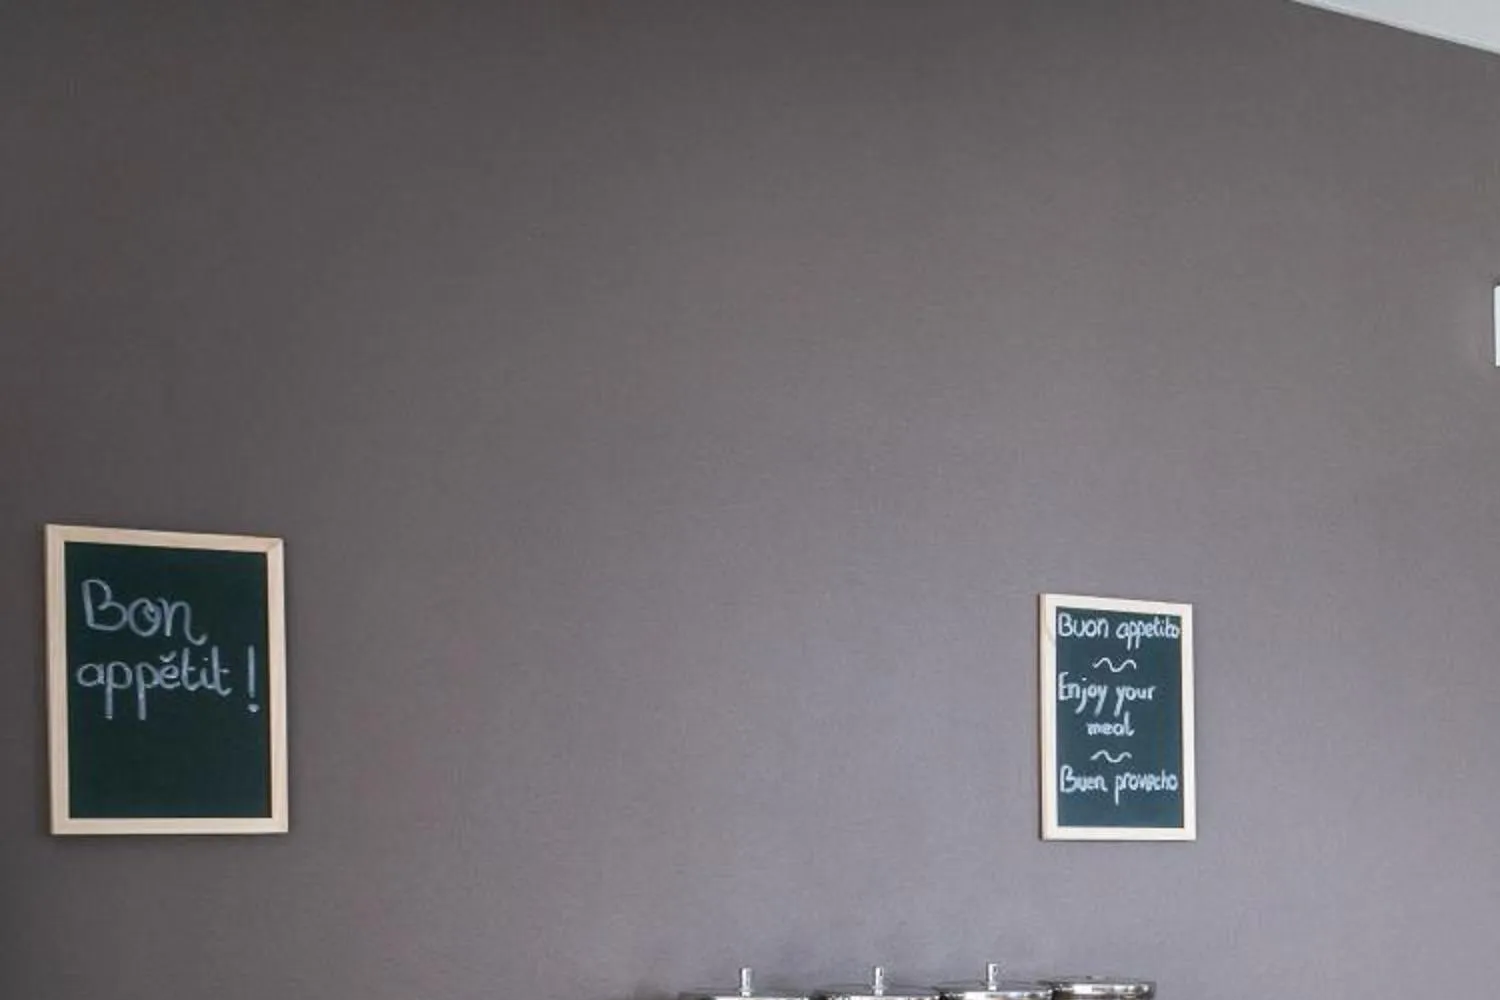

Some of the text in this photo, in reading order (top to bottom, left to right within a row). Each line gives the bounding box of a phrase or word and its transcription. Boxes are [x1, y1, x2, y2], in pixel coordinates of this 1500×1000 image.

[80, 578, 208, 645] Bon
[1058, 612, 1179, 650] Buon appetito
[76, 645, 233, 720] appétit
[1058, 671, 1157, 717] Enjoy your
[1086, 711, 1135, 737] meal
[1059, 764, 1108, 793] Buen
